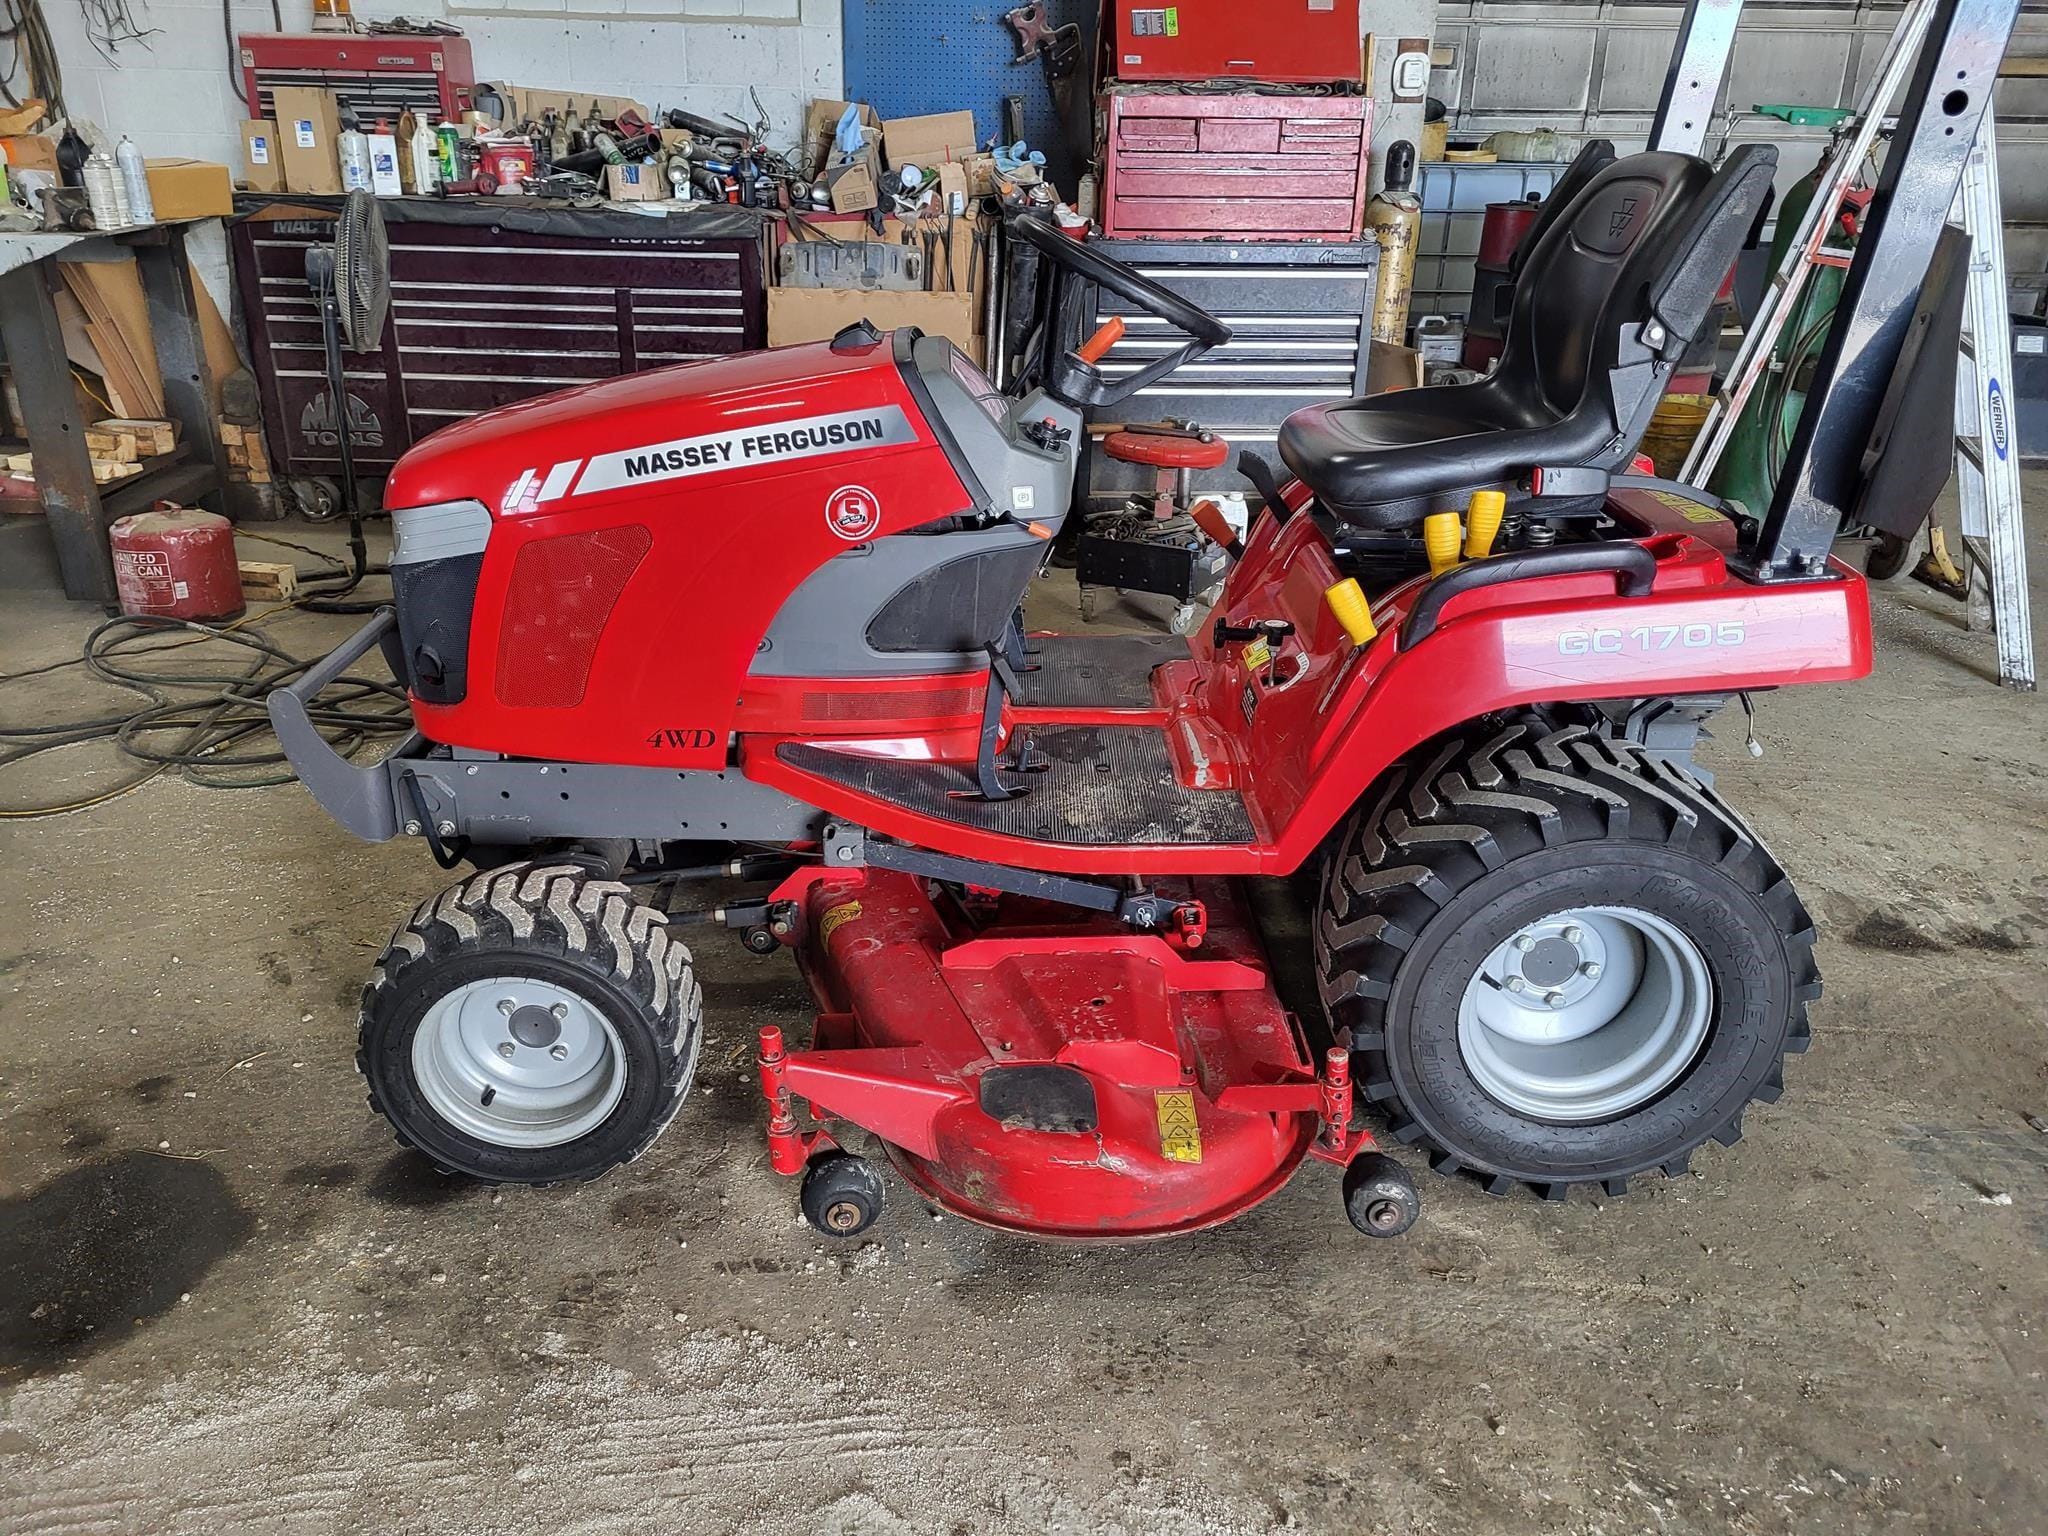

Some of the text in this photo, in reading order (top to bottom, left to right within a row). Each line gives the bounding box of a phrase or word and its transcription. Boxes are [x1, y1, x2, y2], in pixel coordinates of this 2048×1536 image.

[273, 221, 318, 234] MAC
[1992, 396, 2004, 443] WERNER
[624, 419, 882, 478] MASSEY FERGUSON
[137, 566, 163, 577] CAN
[1558, 620, 1746, 656] GC 1705
[646, 729, 715, 748] 4WD
[1641, 875, 1766, 1026] CARLISLE
[1419, 1024, 1456, 1105] CHIEF
